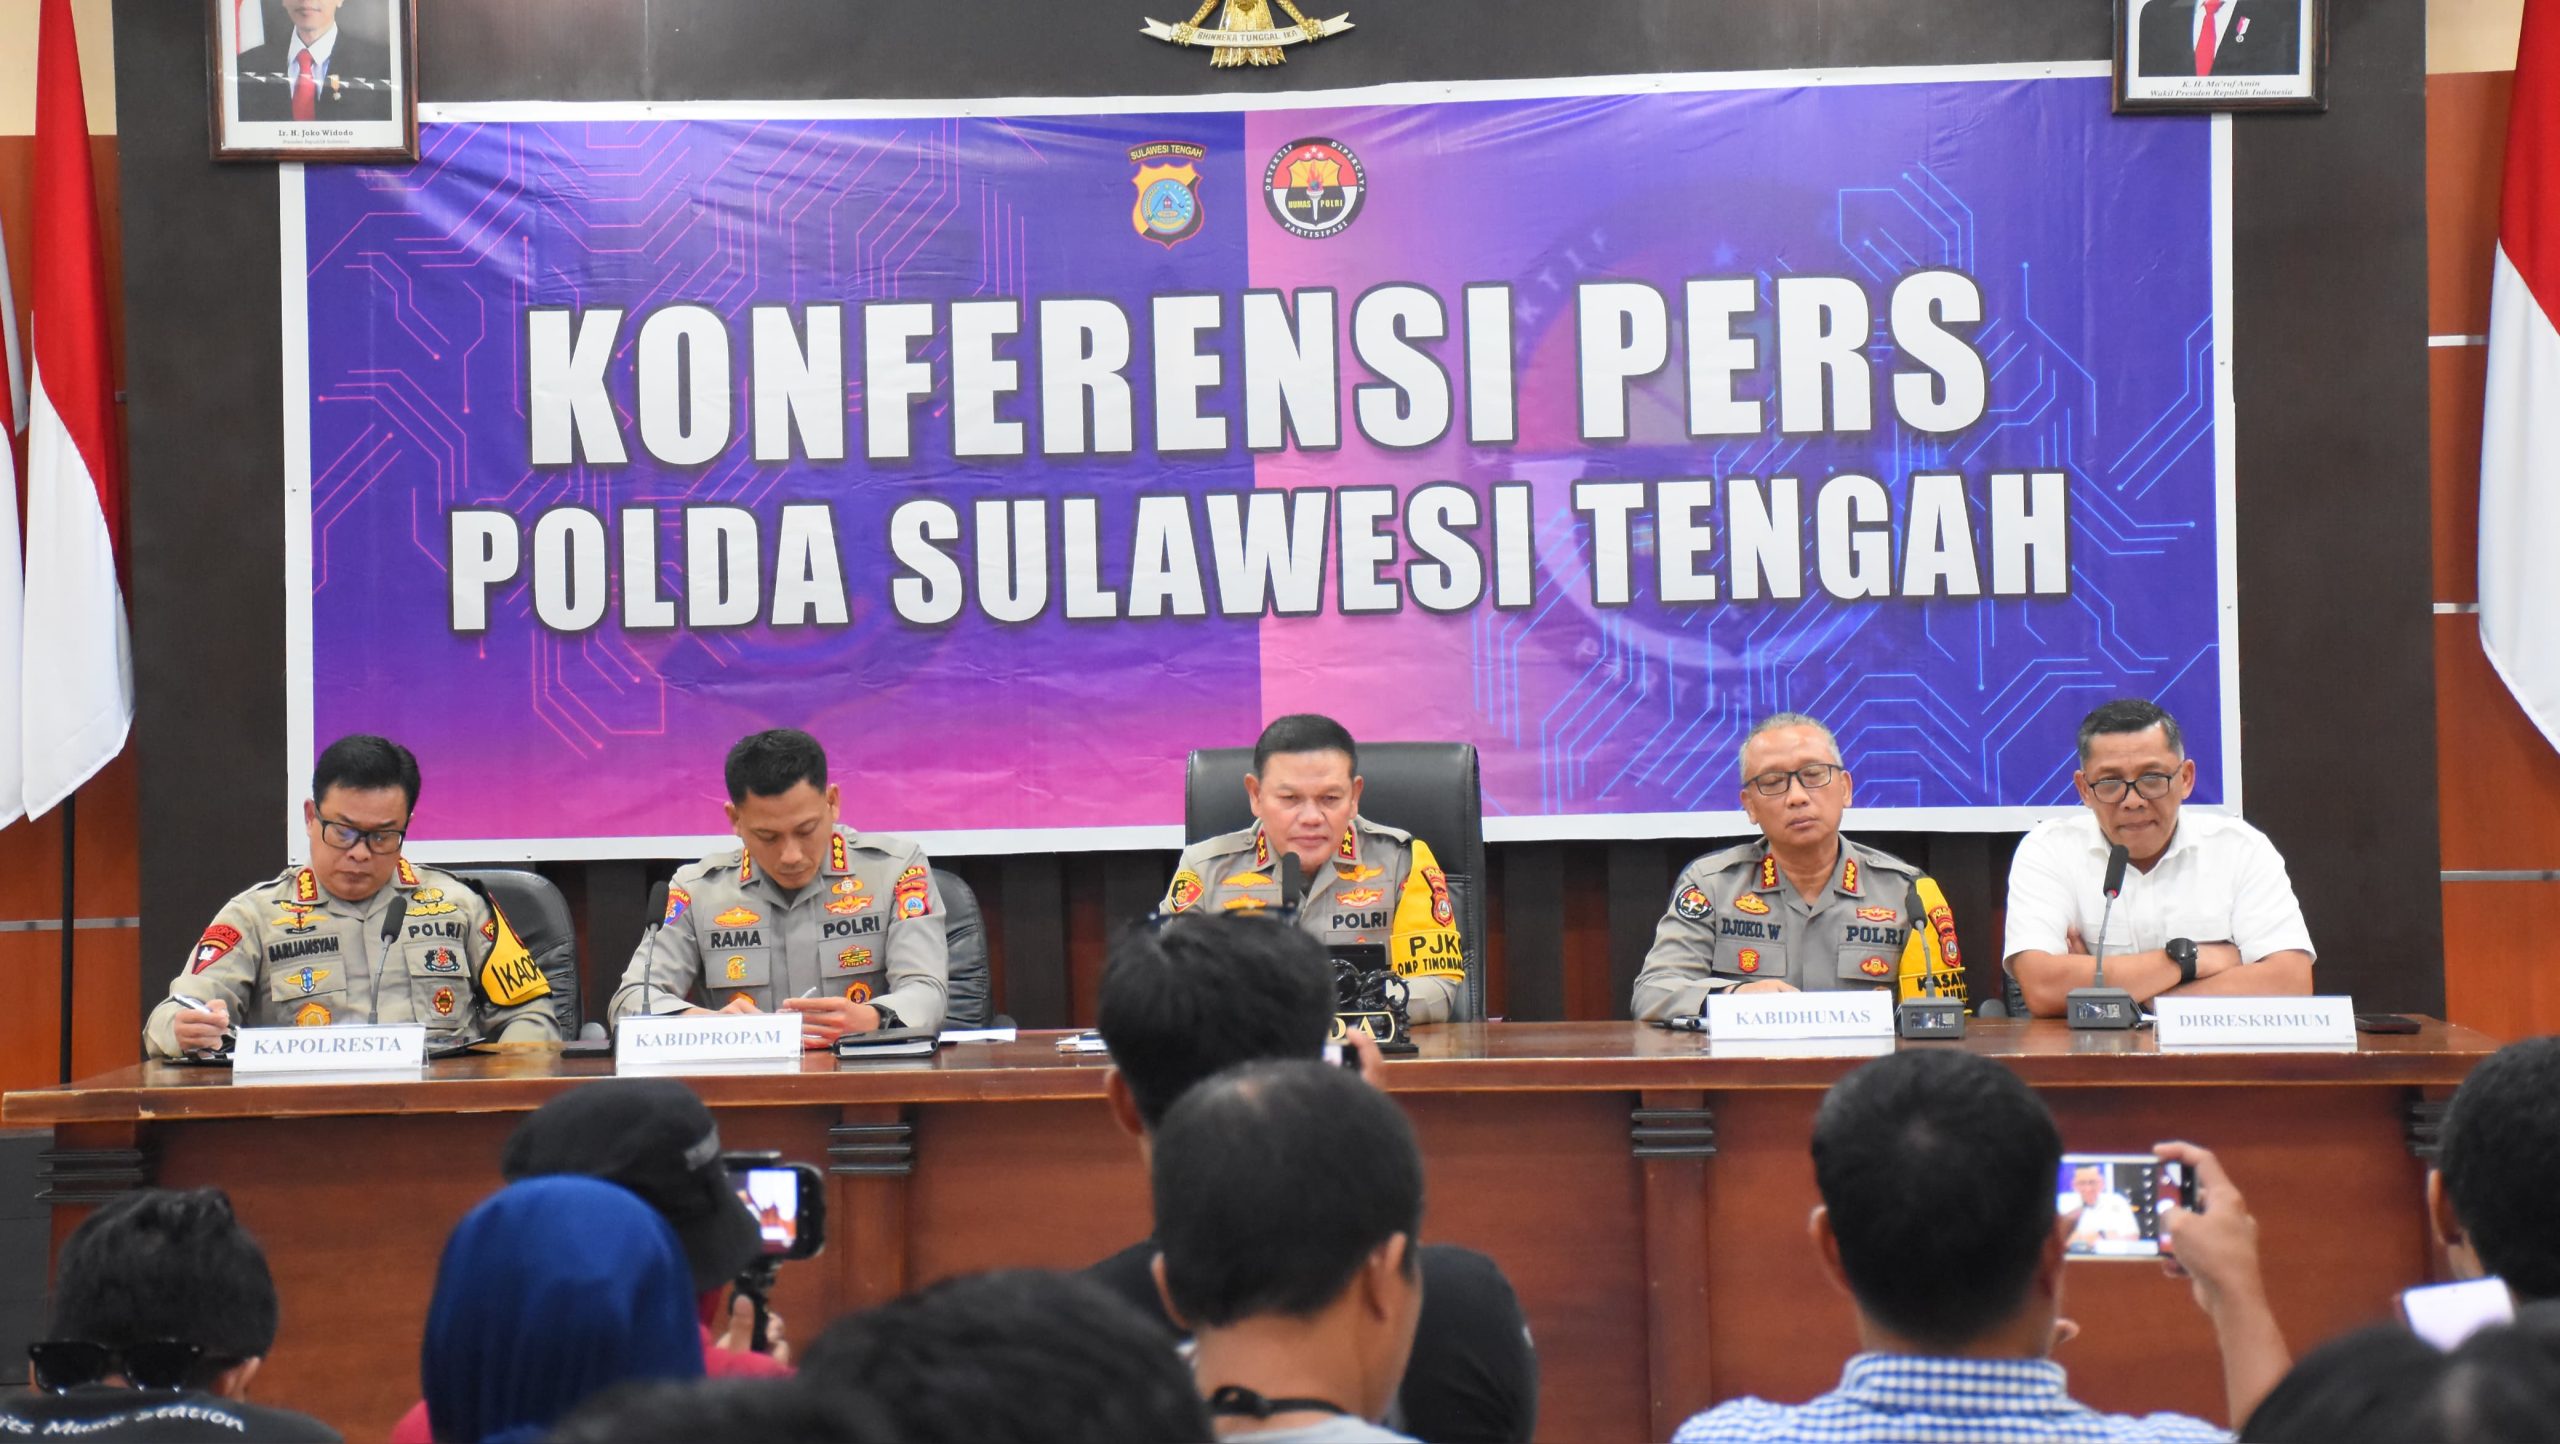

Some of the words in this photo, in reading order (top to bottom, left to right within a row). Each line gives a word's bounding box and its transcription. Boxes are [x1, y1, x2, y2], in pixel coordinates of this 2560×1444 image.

[1197, 31, 1238, 42] BHINNEKA
[1240, 32, 1281, 41] TUNGGAL
[1283, 29, 1298, 39] IKA
[302, 129, 320, 138] Joko
[321, 129, 354, 137] Widodo
[1130, 144, 1169, 160] SULAWESI
[1170, 144, 1203, 158] TENGAH
[1264, 143, 1293, 192] OBYEKTIF
[1330, 141, 1365, 193] DIPERCAYA
[1288, 200, 1312, 209] HUMAS
[1320, 199, 1343, 208] POLRI
[1284, 220, 1349, 238] PARTISIPASI
[529, 283, 1514, 465] KONFERENSI
[1579, 270, 1986, 438] PERS
[451, 504, 849, 631] POLDA
[890, 485, 1532, 624] SULAWESI
[1575, 473, 2068, 606] TENGAH
[823, 915, 880, 938] POLRI
[1332, 911, 1388, 930] POLRI
[408, 921, 461, 939] POLRI
[1768, 923, 1782, 940] W
[1846, 925, 1905, 946] POLRI
[711, 930, 762, 949] RAMA
[1736, 1009, 1872, 1026] KABIDHUMAS
[2179, 1012, 2331, 1028] DIRRESKRIMUM
[253, 1036, 402, 1055] KAPOLRESTA
[635, 1030, 782, 1048] KABIDPROPAM
